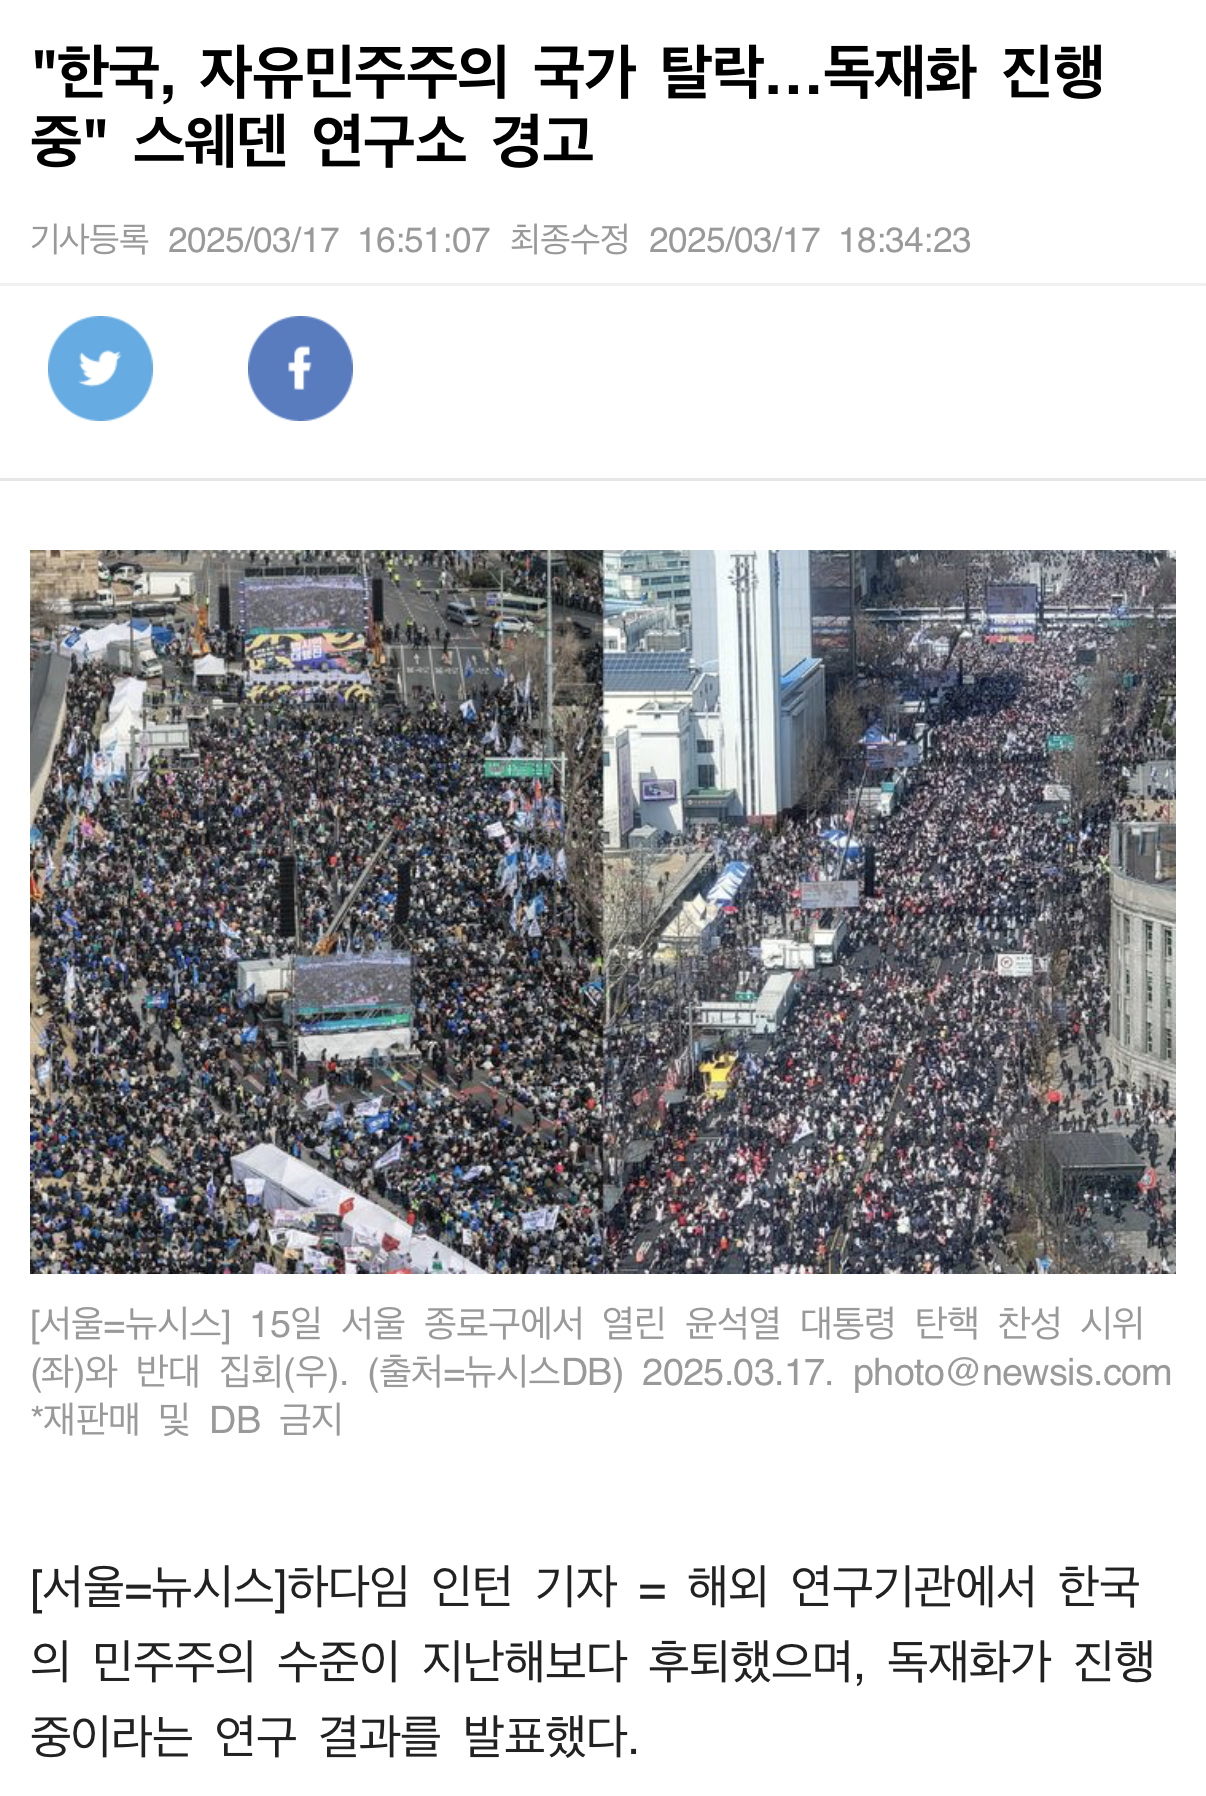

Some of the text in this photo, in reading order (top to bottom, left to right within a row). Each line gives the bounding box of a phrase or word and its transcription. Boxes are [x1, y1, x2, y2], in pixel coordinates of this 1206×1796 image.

[35, 44, 173, 105] "한국,
[200, 44, 505, 99] 자유민주주의
[534, 44, 636, 99] 국가
[1003, 44, 1101, 99] 진행
[31, 113, 593, 168] 중" 스웨덴 연구소 경고
[32, 223, 970, 255] 기사등록 2025/03/17 16:51:07 최종수정 2025/03/17 18:34:23
[32, 1306, 1141, 1345] [서울=뉴시스] 15일 서울 종로구에서 열린 윤석열 대통령 탄핵 찬성 시위
[32, 1354, 1170, 1393] (좌)와 반대 집회(우). (출처=뉴시스DB) 2025.03.17. photo@newsis.com
[161, 1402, 188, 1436] 및
[212, 1406, 260, 1433] DB
[280, 1402, 340, 1436] 금지
[33, 1565, 1139, 1614] [서울=뉴시스]하다임 인턴 기자 = 해외 연구기관에서 한국
[32, 1640, 1152, 1686] 의 민주주의 수준이 지난해보다 후퇴했으며, 독재화가 진행
[31, 1715, 636, 1758] 중이라는 연구 결과를 발표했다.
